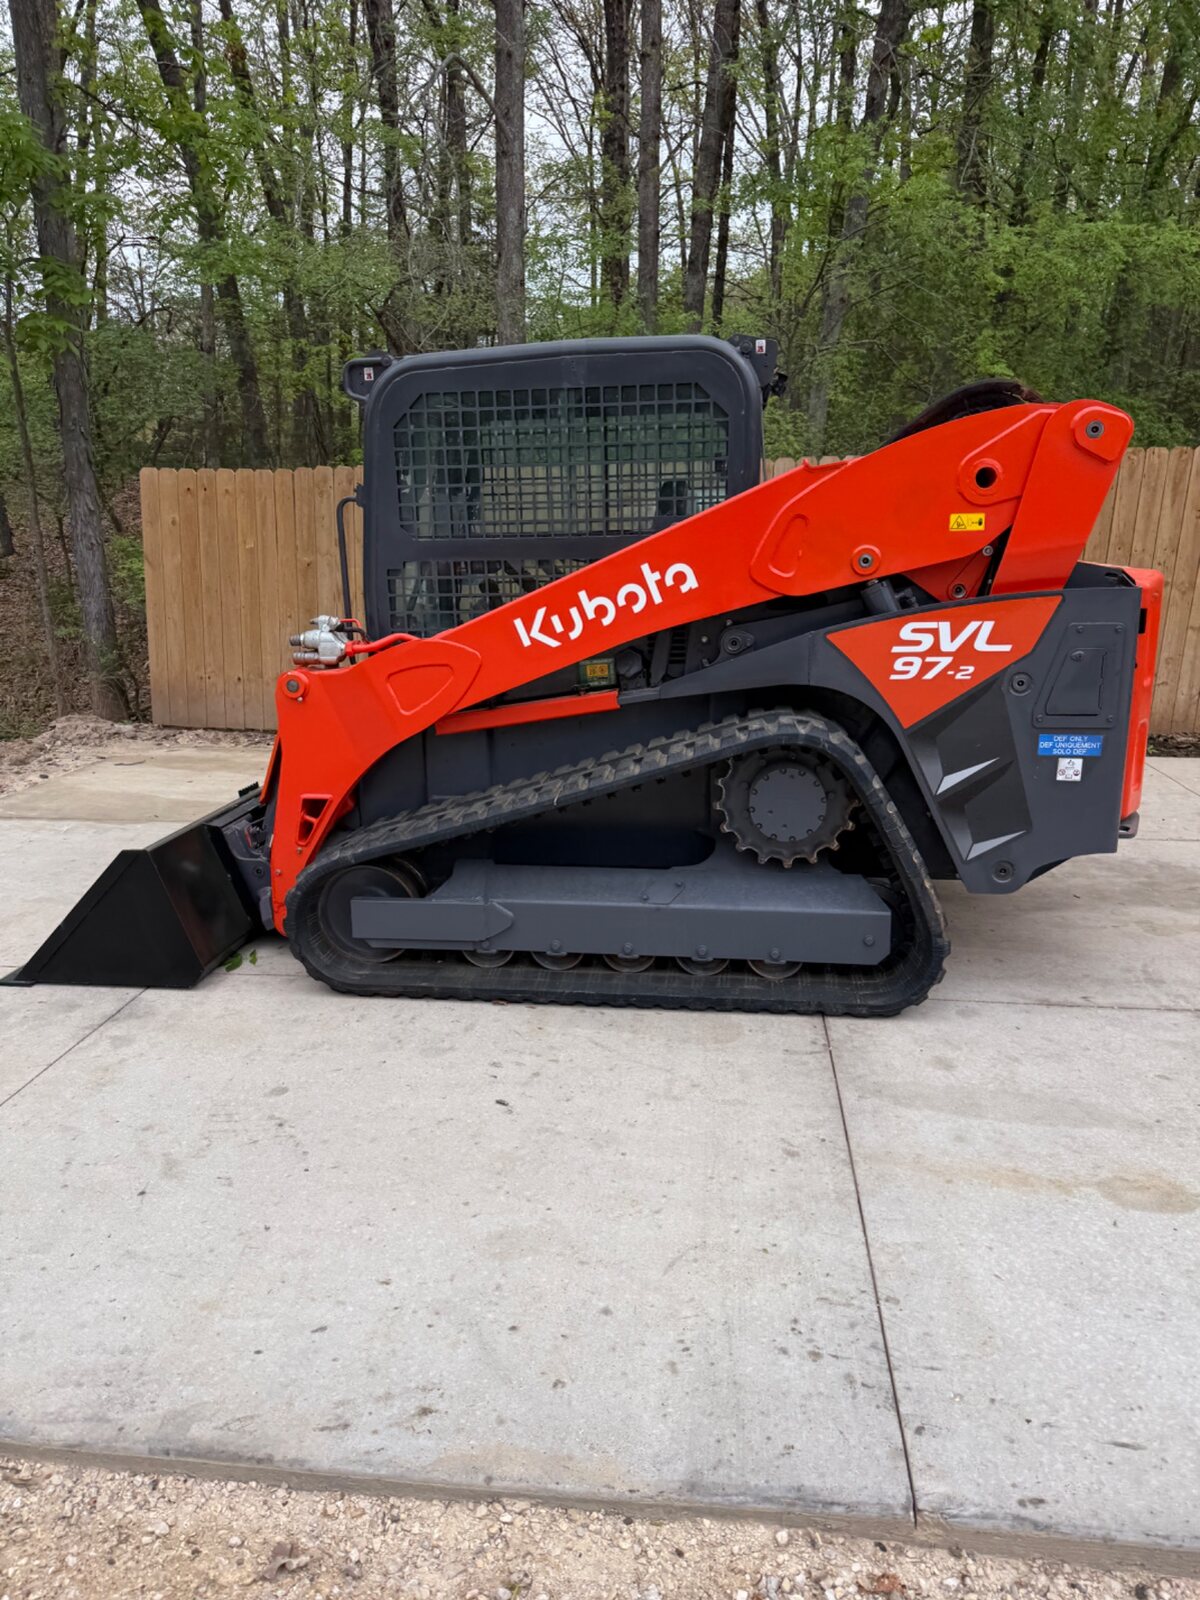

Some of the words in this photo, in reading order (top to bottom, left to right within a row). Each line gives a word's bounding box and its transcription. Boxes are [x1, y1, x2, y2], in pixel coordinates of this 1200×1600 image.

[513, 563, 699, 648] Kubota
[890, 621, 1013, 653] SVL
[889, 656, 975, 680] 97-2
[1040, 741, 1054, 749] DEF
